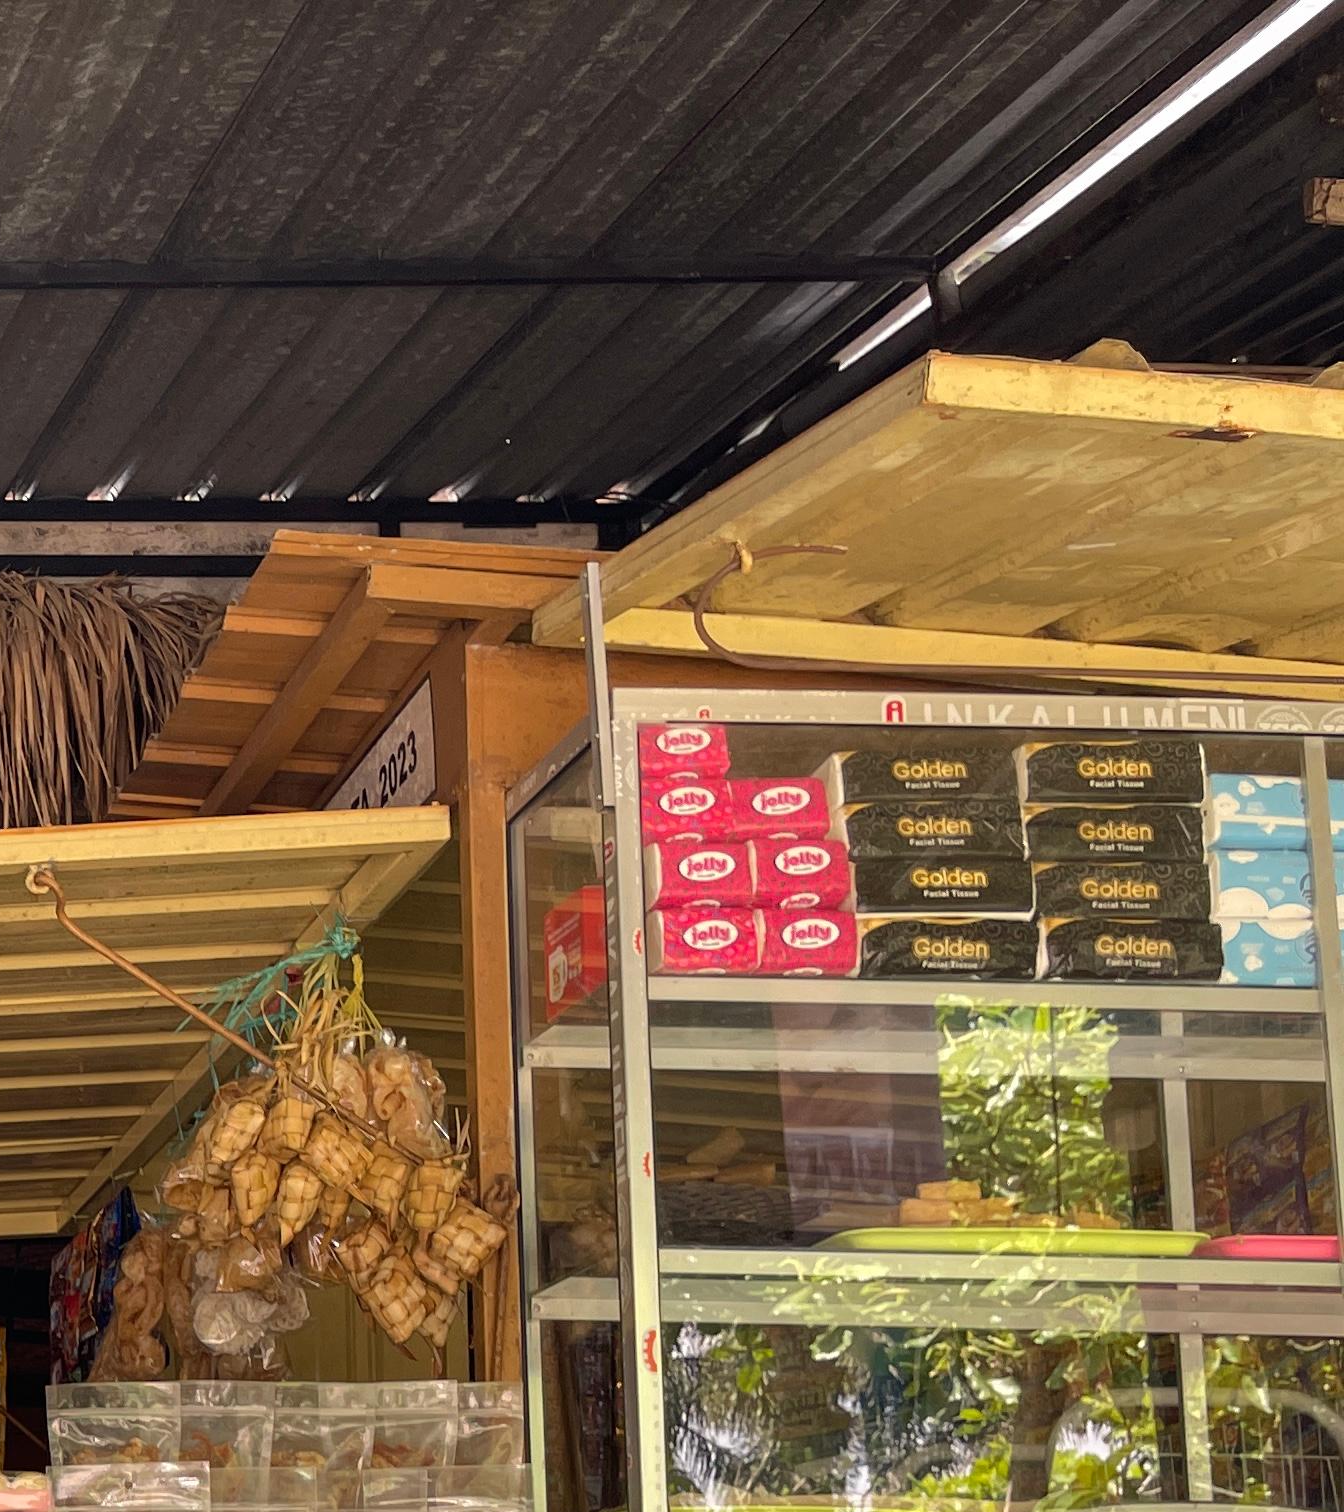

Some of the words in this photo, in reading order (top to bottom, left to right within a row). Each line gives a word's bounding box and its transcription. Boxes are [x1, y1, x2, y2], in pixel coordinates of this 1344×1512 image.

[664, 731, 703, 749] jolly
[377, 730, 419, 808] 2023
[892, 759, 968, 780] Golden
[1078, 757, 1152, 778] Golden
[668, 789, 708, 810] jolly
[761, 788, 802, 809] jolly
[897, 816, 973, 836] Golden
[1078, 822, 1153, 841] Golden
[687, 856, 727, 875] jolly
[783, 850, 824, 870] jolly
[911, 867, 988, 887] Golden
[1080, 879, 1159, 898] Golden
[691, 924, 731, 944] jolly
[791, 923, 833, 943] jolly
[913, 936, 990, 958] Golden
[1095, 936, 1172, 957] Golden
